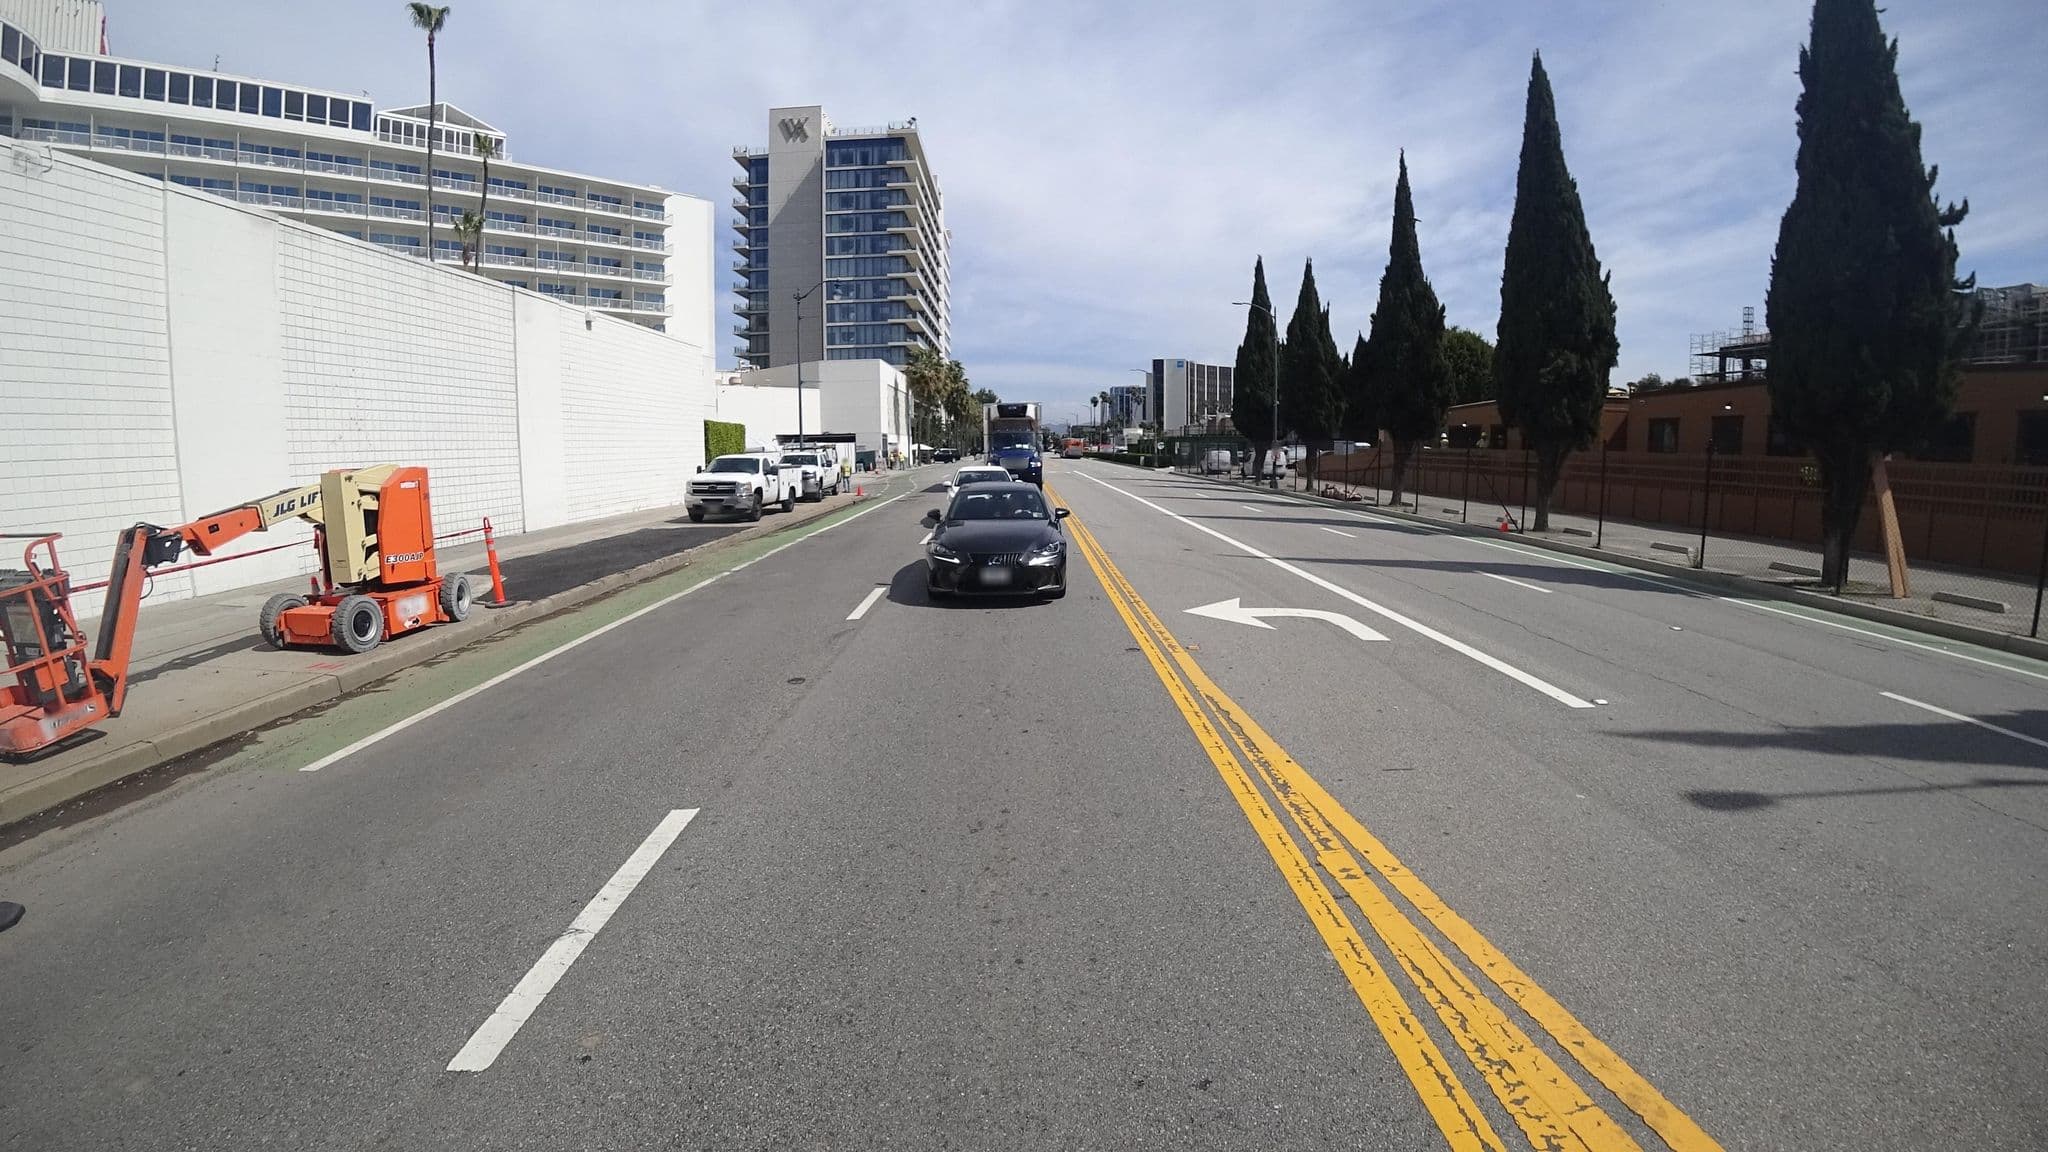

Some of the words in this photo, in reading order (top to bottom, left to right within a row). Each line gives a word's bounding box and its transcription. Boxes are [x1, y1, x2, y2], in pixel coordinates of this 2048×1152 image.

[273, 499, 296, 517] JLG
[300, 491, 320, 508] LIF
[385, 552, 424, 564] E300AJP
